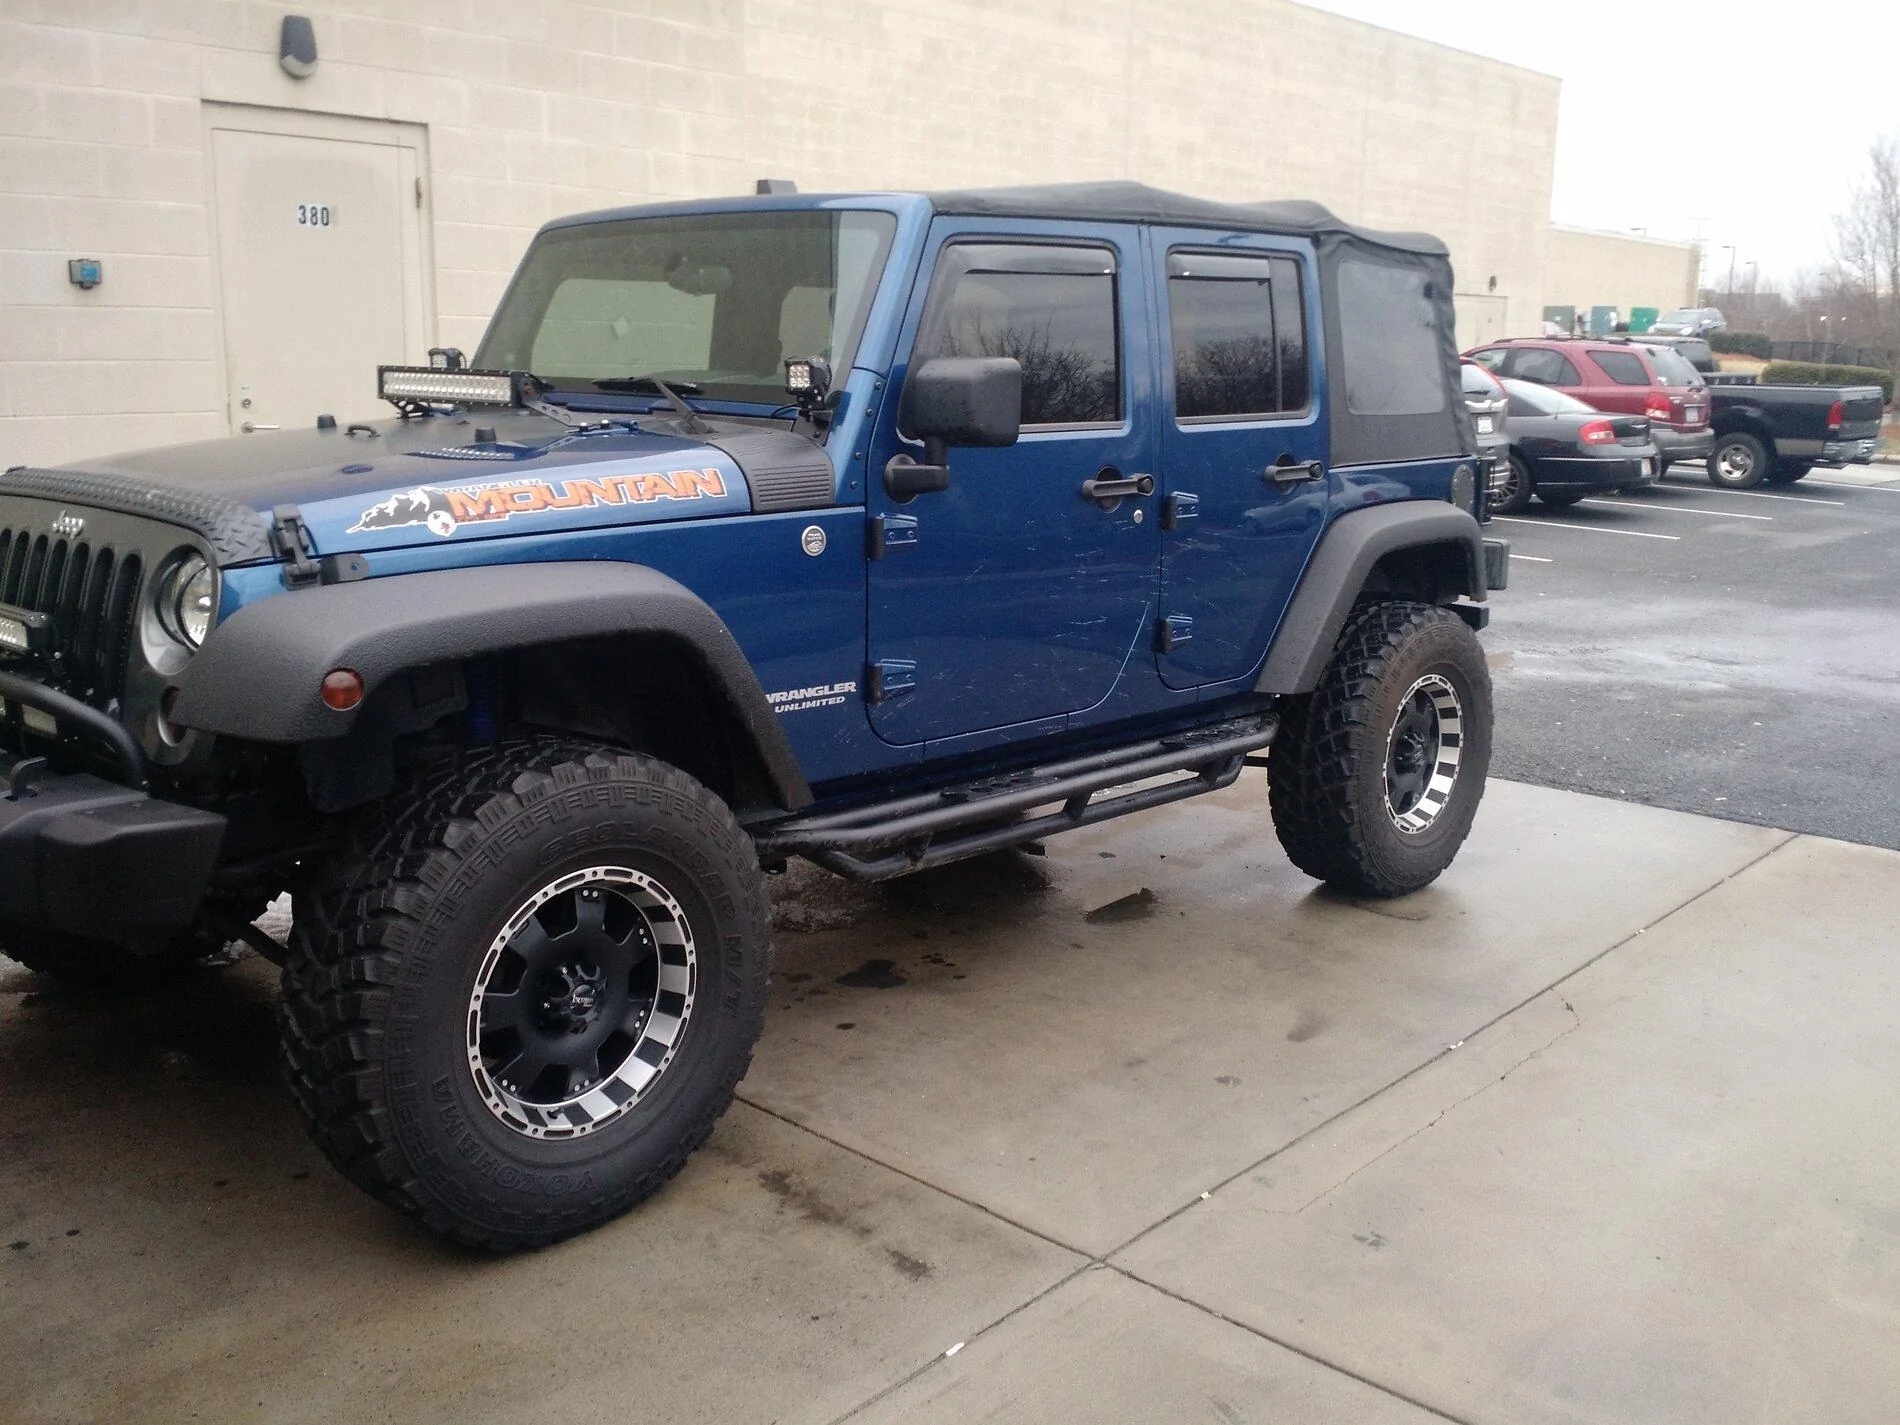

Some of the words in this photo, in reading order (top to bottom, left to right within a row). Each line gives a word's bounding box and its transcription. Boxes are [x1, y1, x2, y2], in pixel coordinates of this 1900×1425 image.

[298, 204, 330, 227] 380
[444, 468, 727, 519] MOUNTAIN
[774, 695, 846, 714] UNLIMITED
